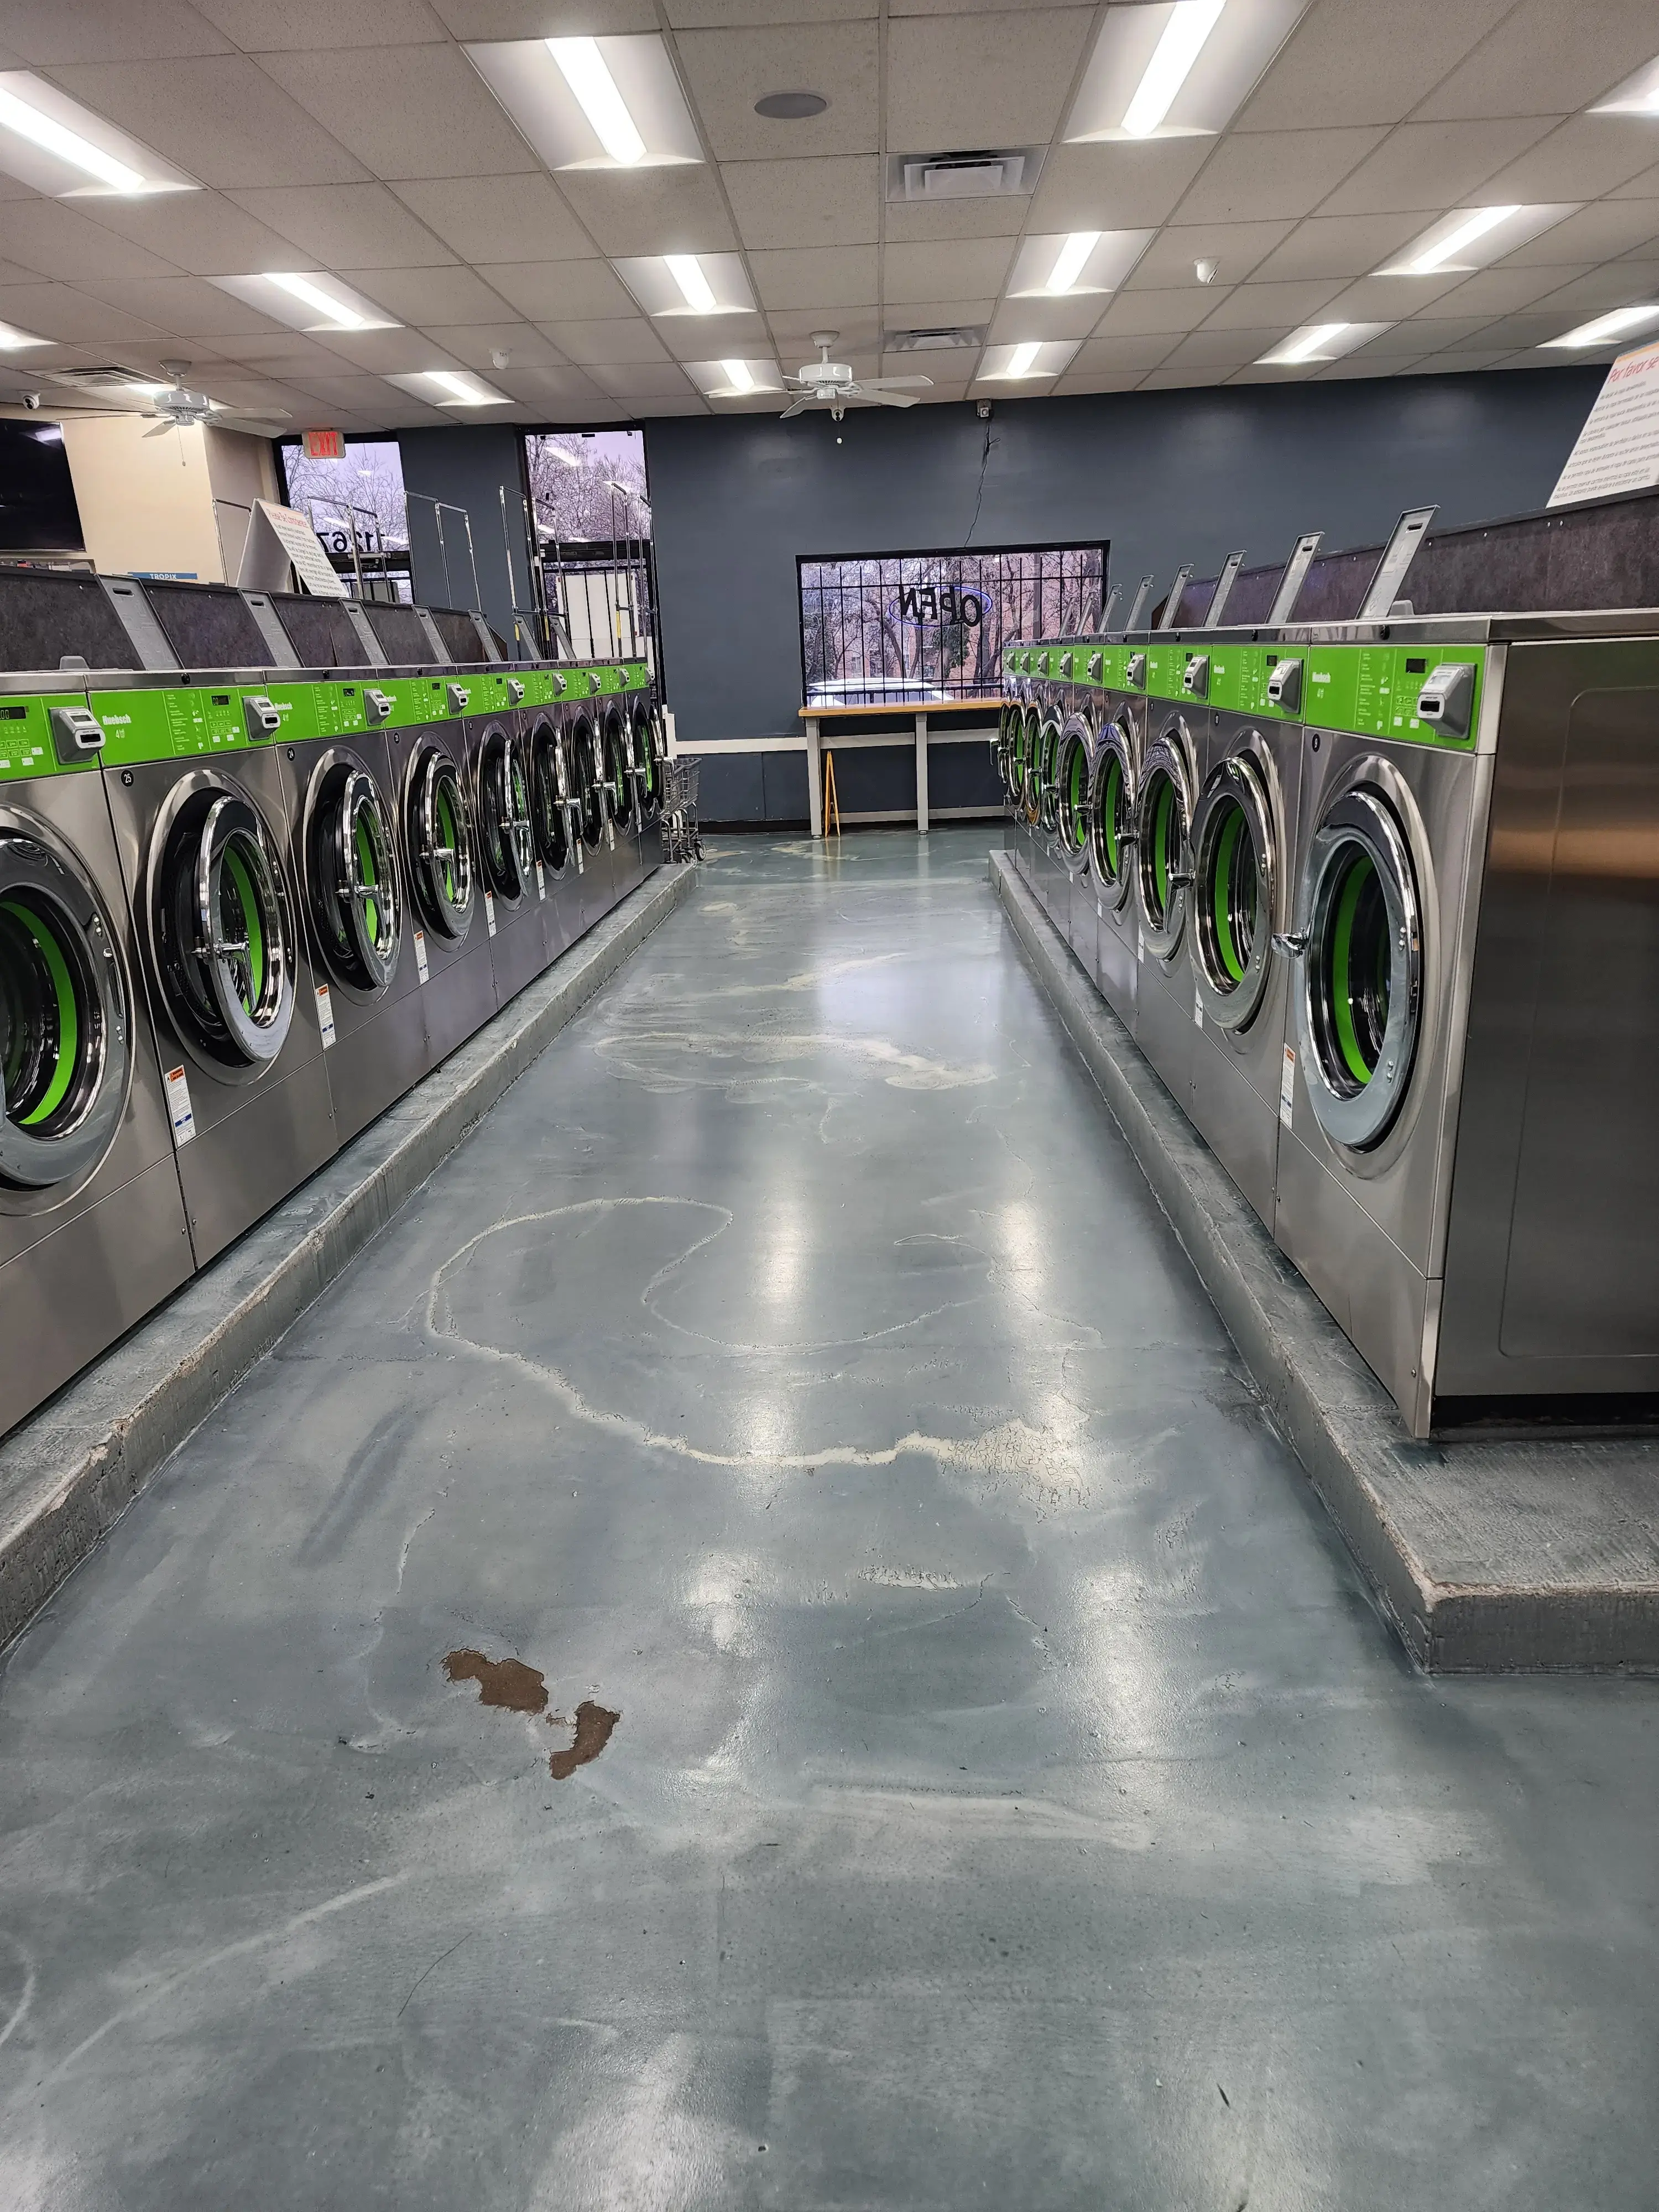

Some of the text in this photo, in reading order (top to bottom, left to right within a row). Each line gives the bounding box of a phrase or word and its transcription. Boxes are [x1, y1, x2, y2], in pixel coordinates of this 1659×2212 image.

[1606, 368, 1626, 384] Por
[1622, 361, 1649, 379] favor
[308, 431, 338, 456] EXIT
[288, 750, 294, 758] 24
[124, 774, 132, 784] 25
